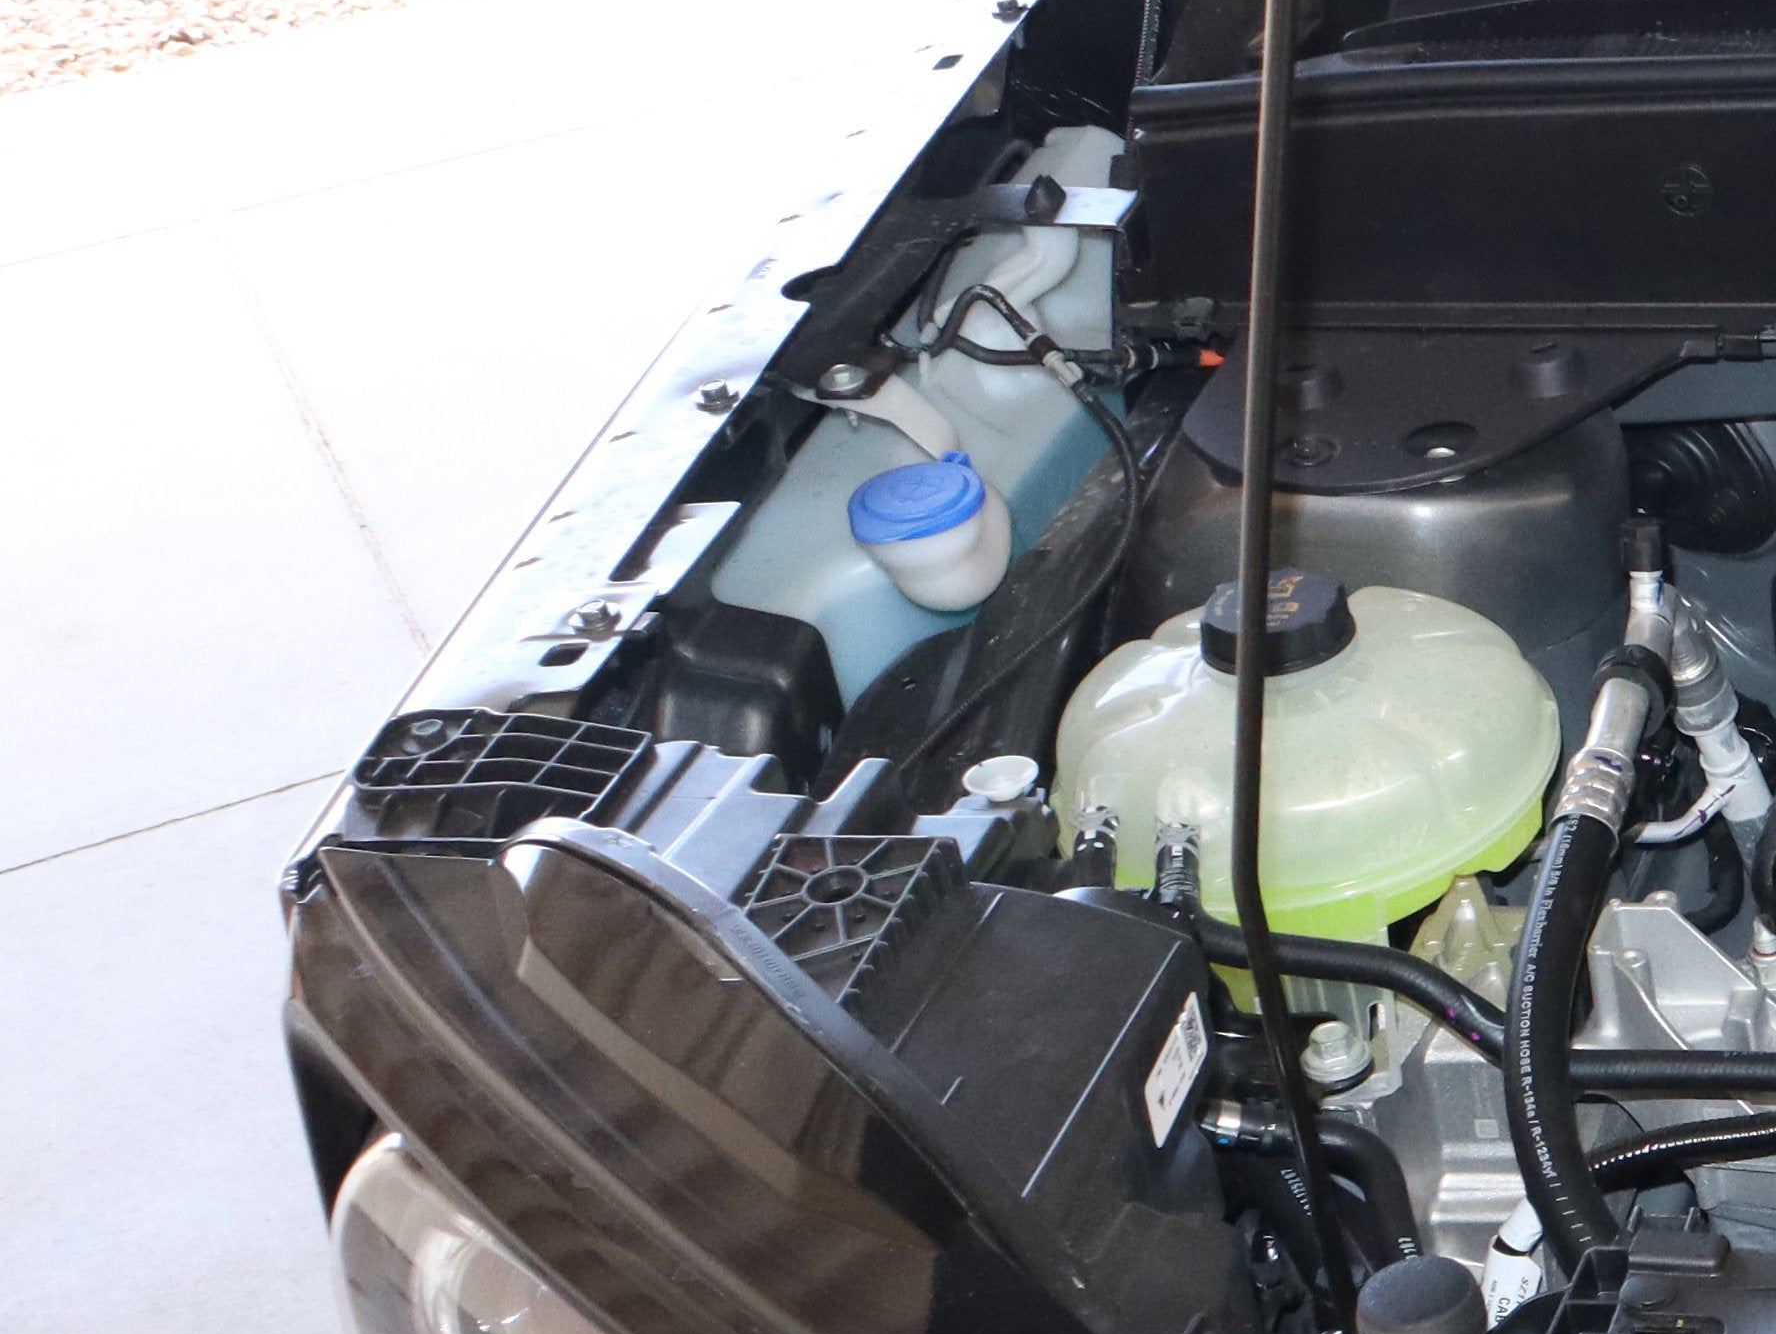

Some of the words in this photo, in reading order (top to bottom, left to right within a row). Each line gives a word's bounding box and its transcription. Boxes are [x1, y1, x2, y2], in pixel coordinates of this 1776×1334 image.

[1528, 898, 1554, 959] Flexbarrier
[1522, 963, 1537, 983] A/C
[1519, 985, 1535, 1038] SUCTION
[1519, 1040, 1532, 1075] HOSE
